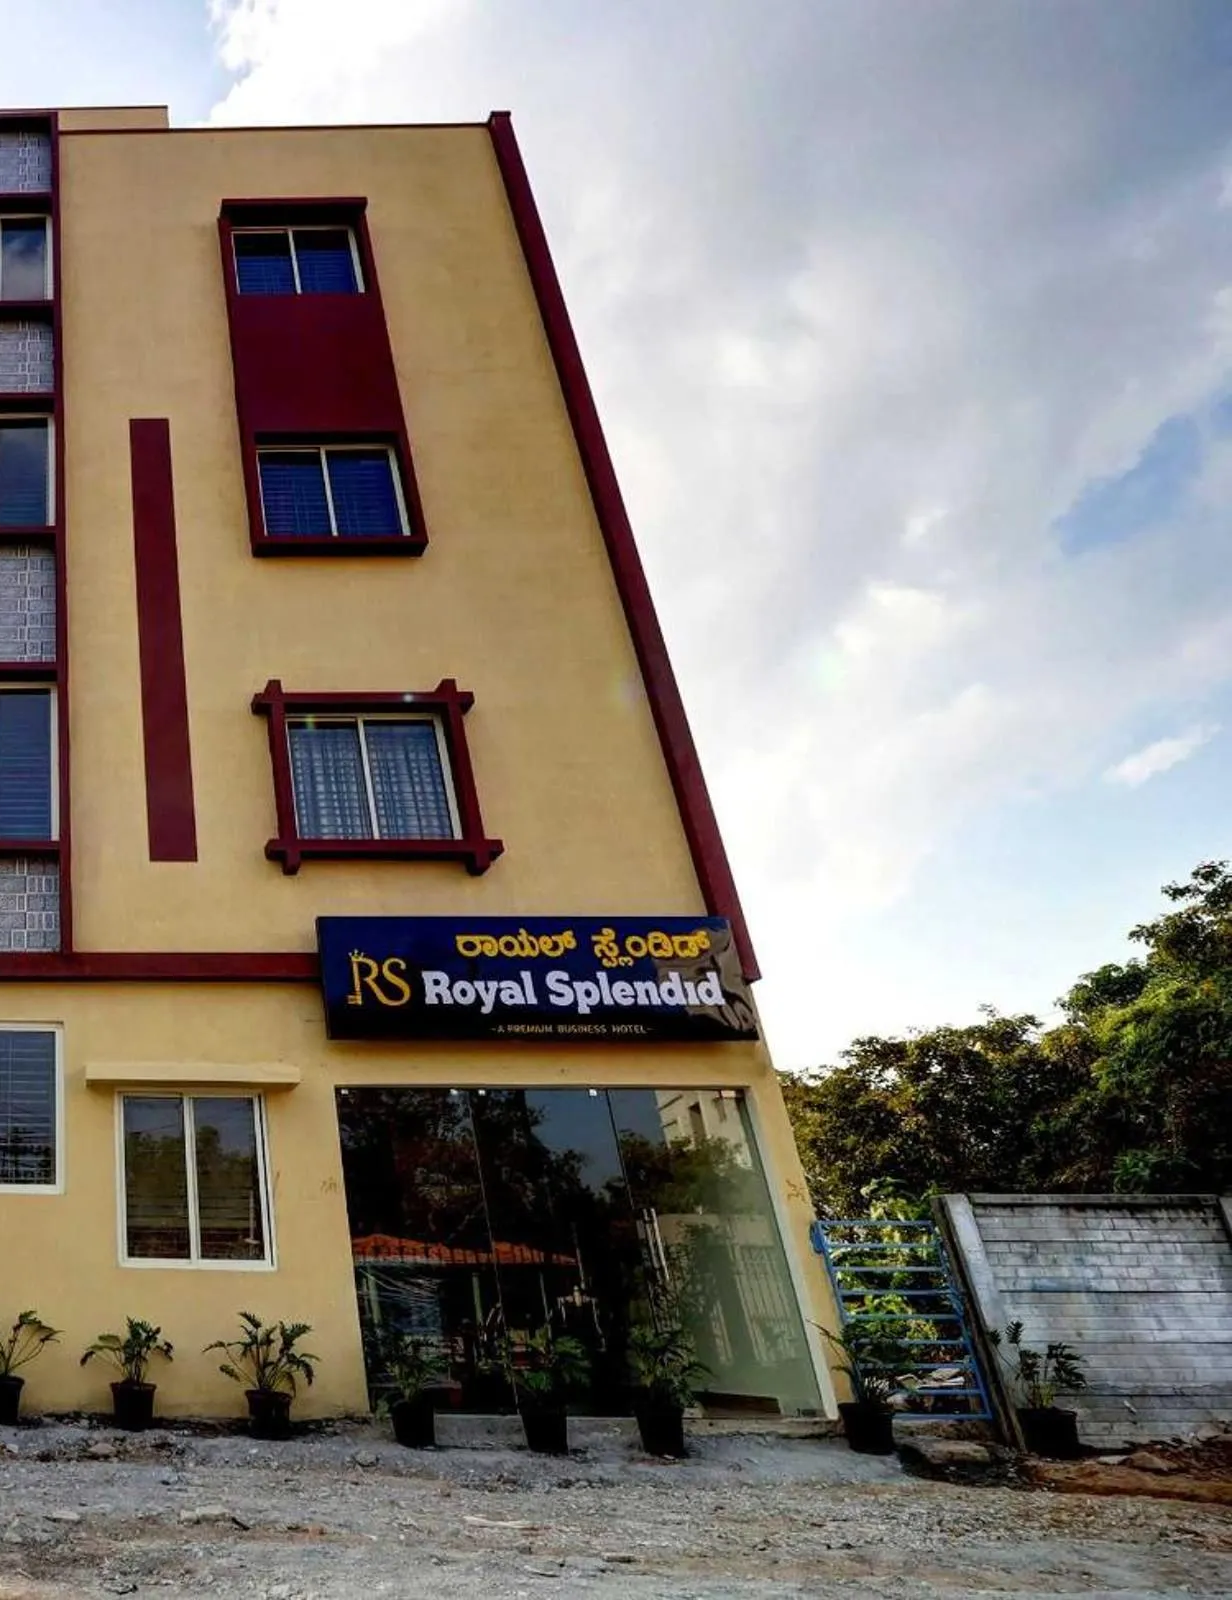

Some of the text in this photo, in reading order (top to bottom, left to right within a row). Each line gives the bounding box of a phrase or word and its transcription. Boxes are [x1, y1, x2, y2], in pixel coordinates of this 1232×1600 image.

[455, 927, 577, 958] ರಾಯಲ್
[346, 950, 412, 1006] RS
[421, 970, 726, 1014] Royal Splendid
[507, 1024, 553, 1034] PREMIUM
[557, 1024, 608, 1034] BUSINESS
[611, 1024, 647, 1034] HOTEL
